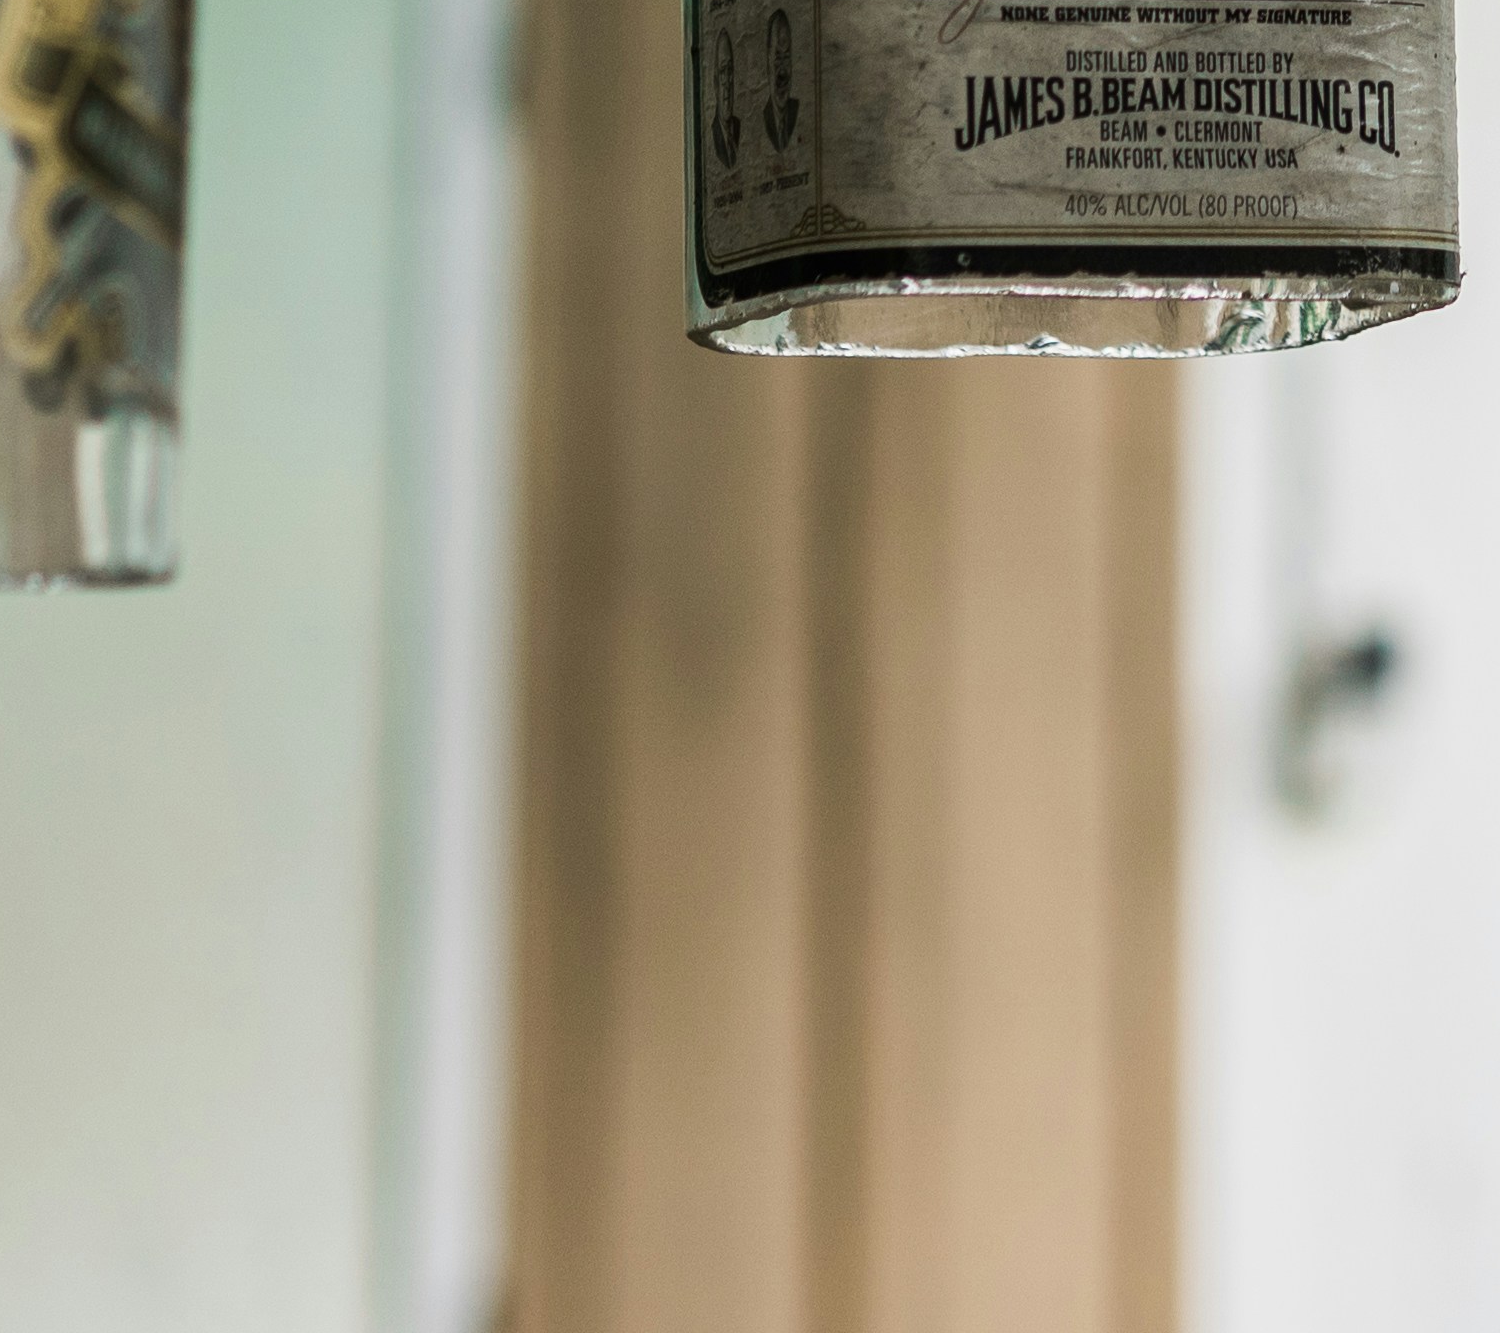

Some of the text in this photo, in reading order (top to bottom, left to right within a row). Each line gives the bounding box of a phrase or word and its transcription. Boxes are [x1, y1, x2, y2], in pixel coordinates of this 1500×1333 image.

[1001, 6, 1352, 26] NONE GENUINE WITHOUT MY SIGNATURE
[1066, 51, 1294, 75] DISTILLED AND BOTTLED BY
[954, 76, 1065, 151] JAMES
[1102, 77, 1186, 115] BEAM
[1193, 78, 1353, 134] DISTILLING
[1357, 79, 1401, 159] CO.
[1100, 121, 1263, 143] BEAM CLERMONT
[1065, 147, 1299, 171] FRANKFORT, KENTUCKY USA
[1064, 195, 1299, 220] 40% ALC/VOL (80 PROOF)
